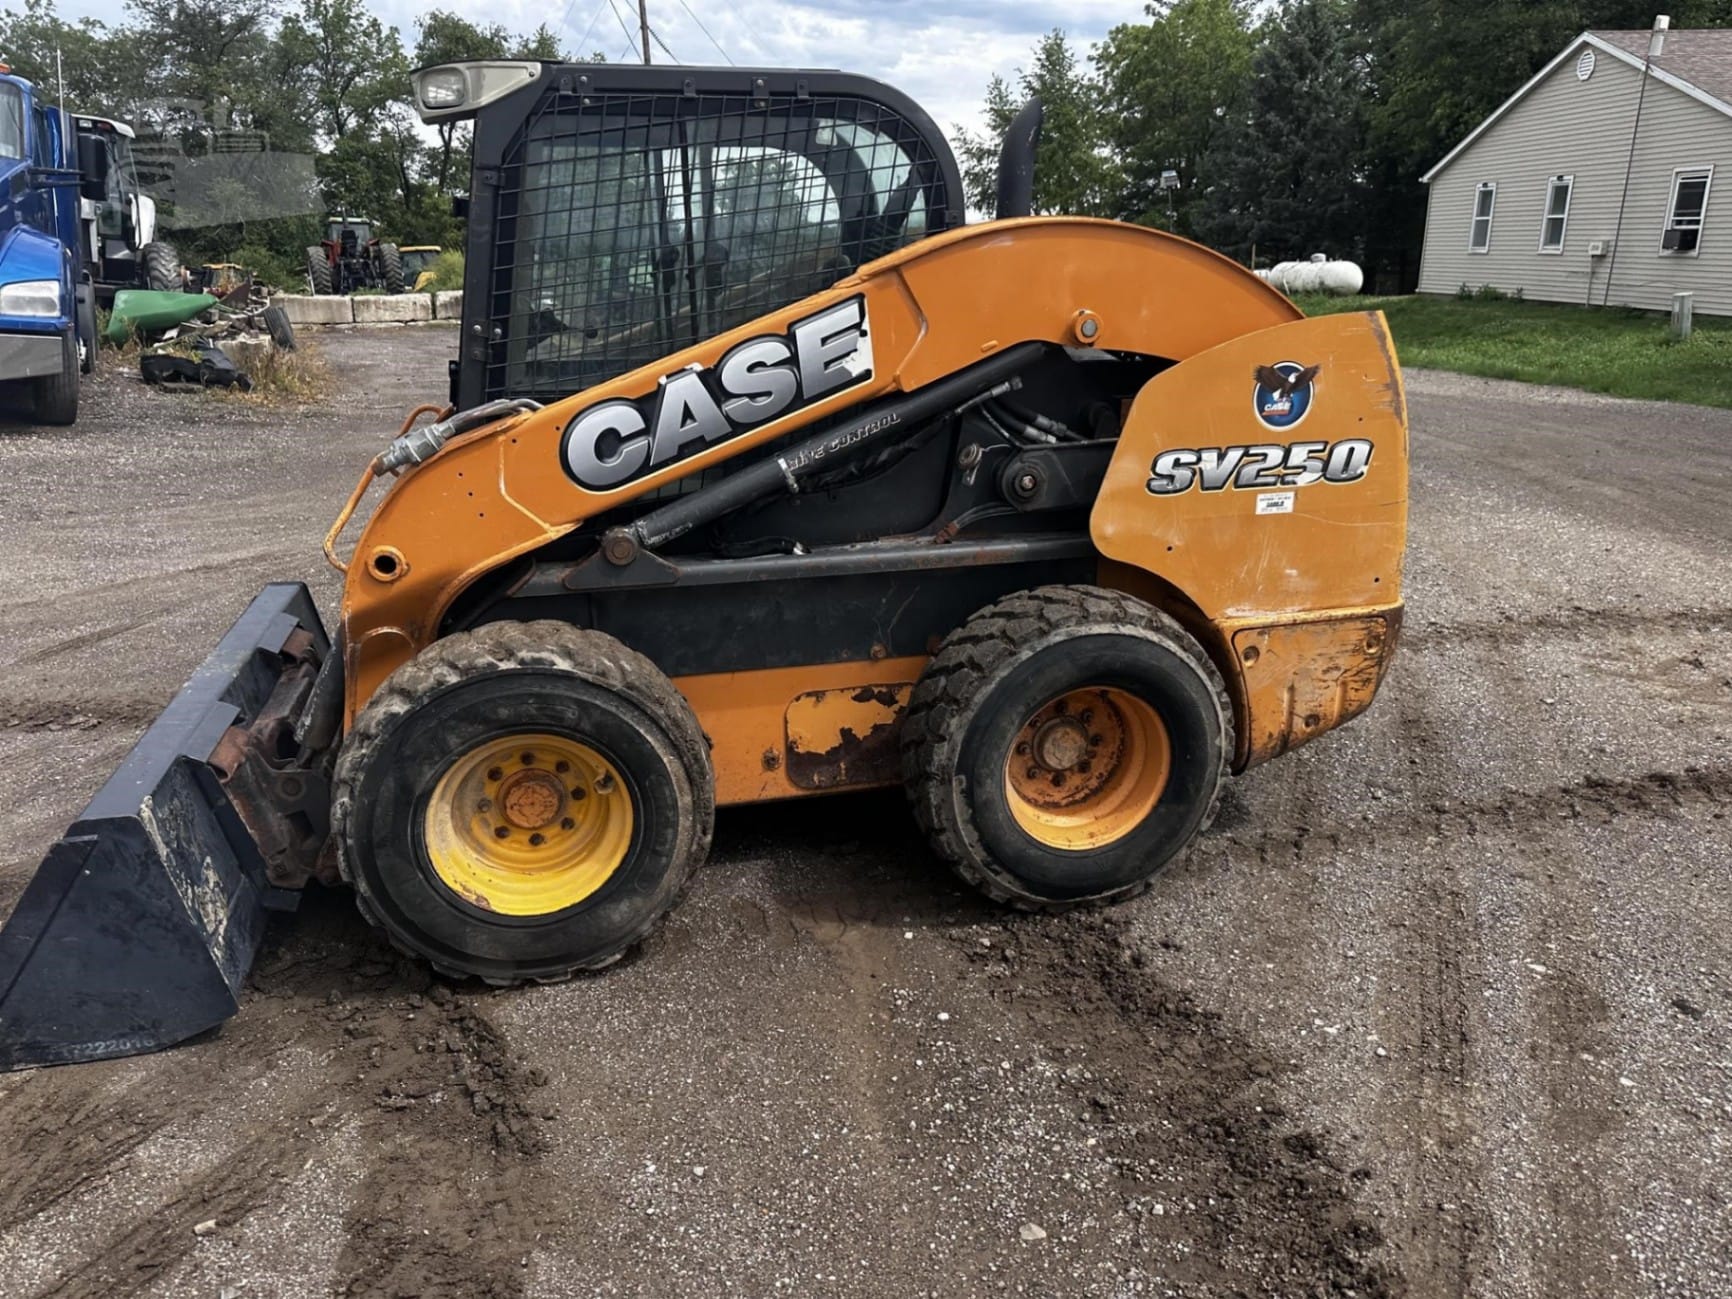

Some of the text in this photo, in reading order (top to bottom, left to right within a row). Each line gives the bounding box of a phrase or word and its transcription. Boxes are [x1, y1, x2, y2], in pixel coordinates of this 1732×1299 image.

[564, 299, 864, 488] CASE
[1263, 401, 1292, 412] CASE
[829, 413, 901, 452] CONTROL
[1147, 438, 1375, 494] SV250
